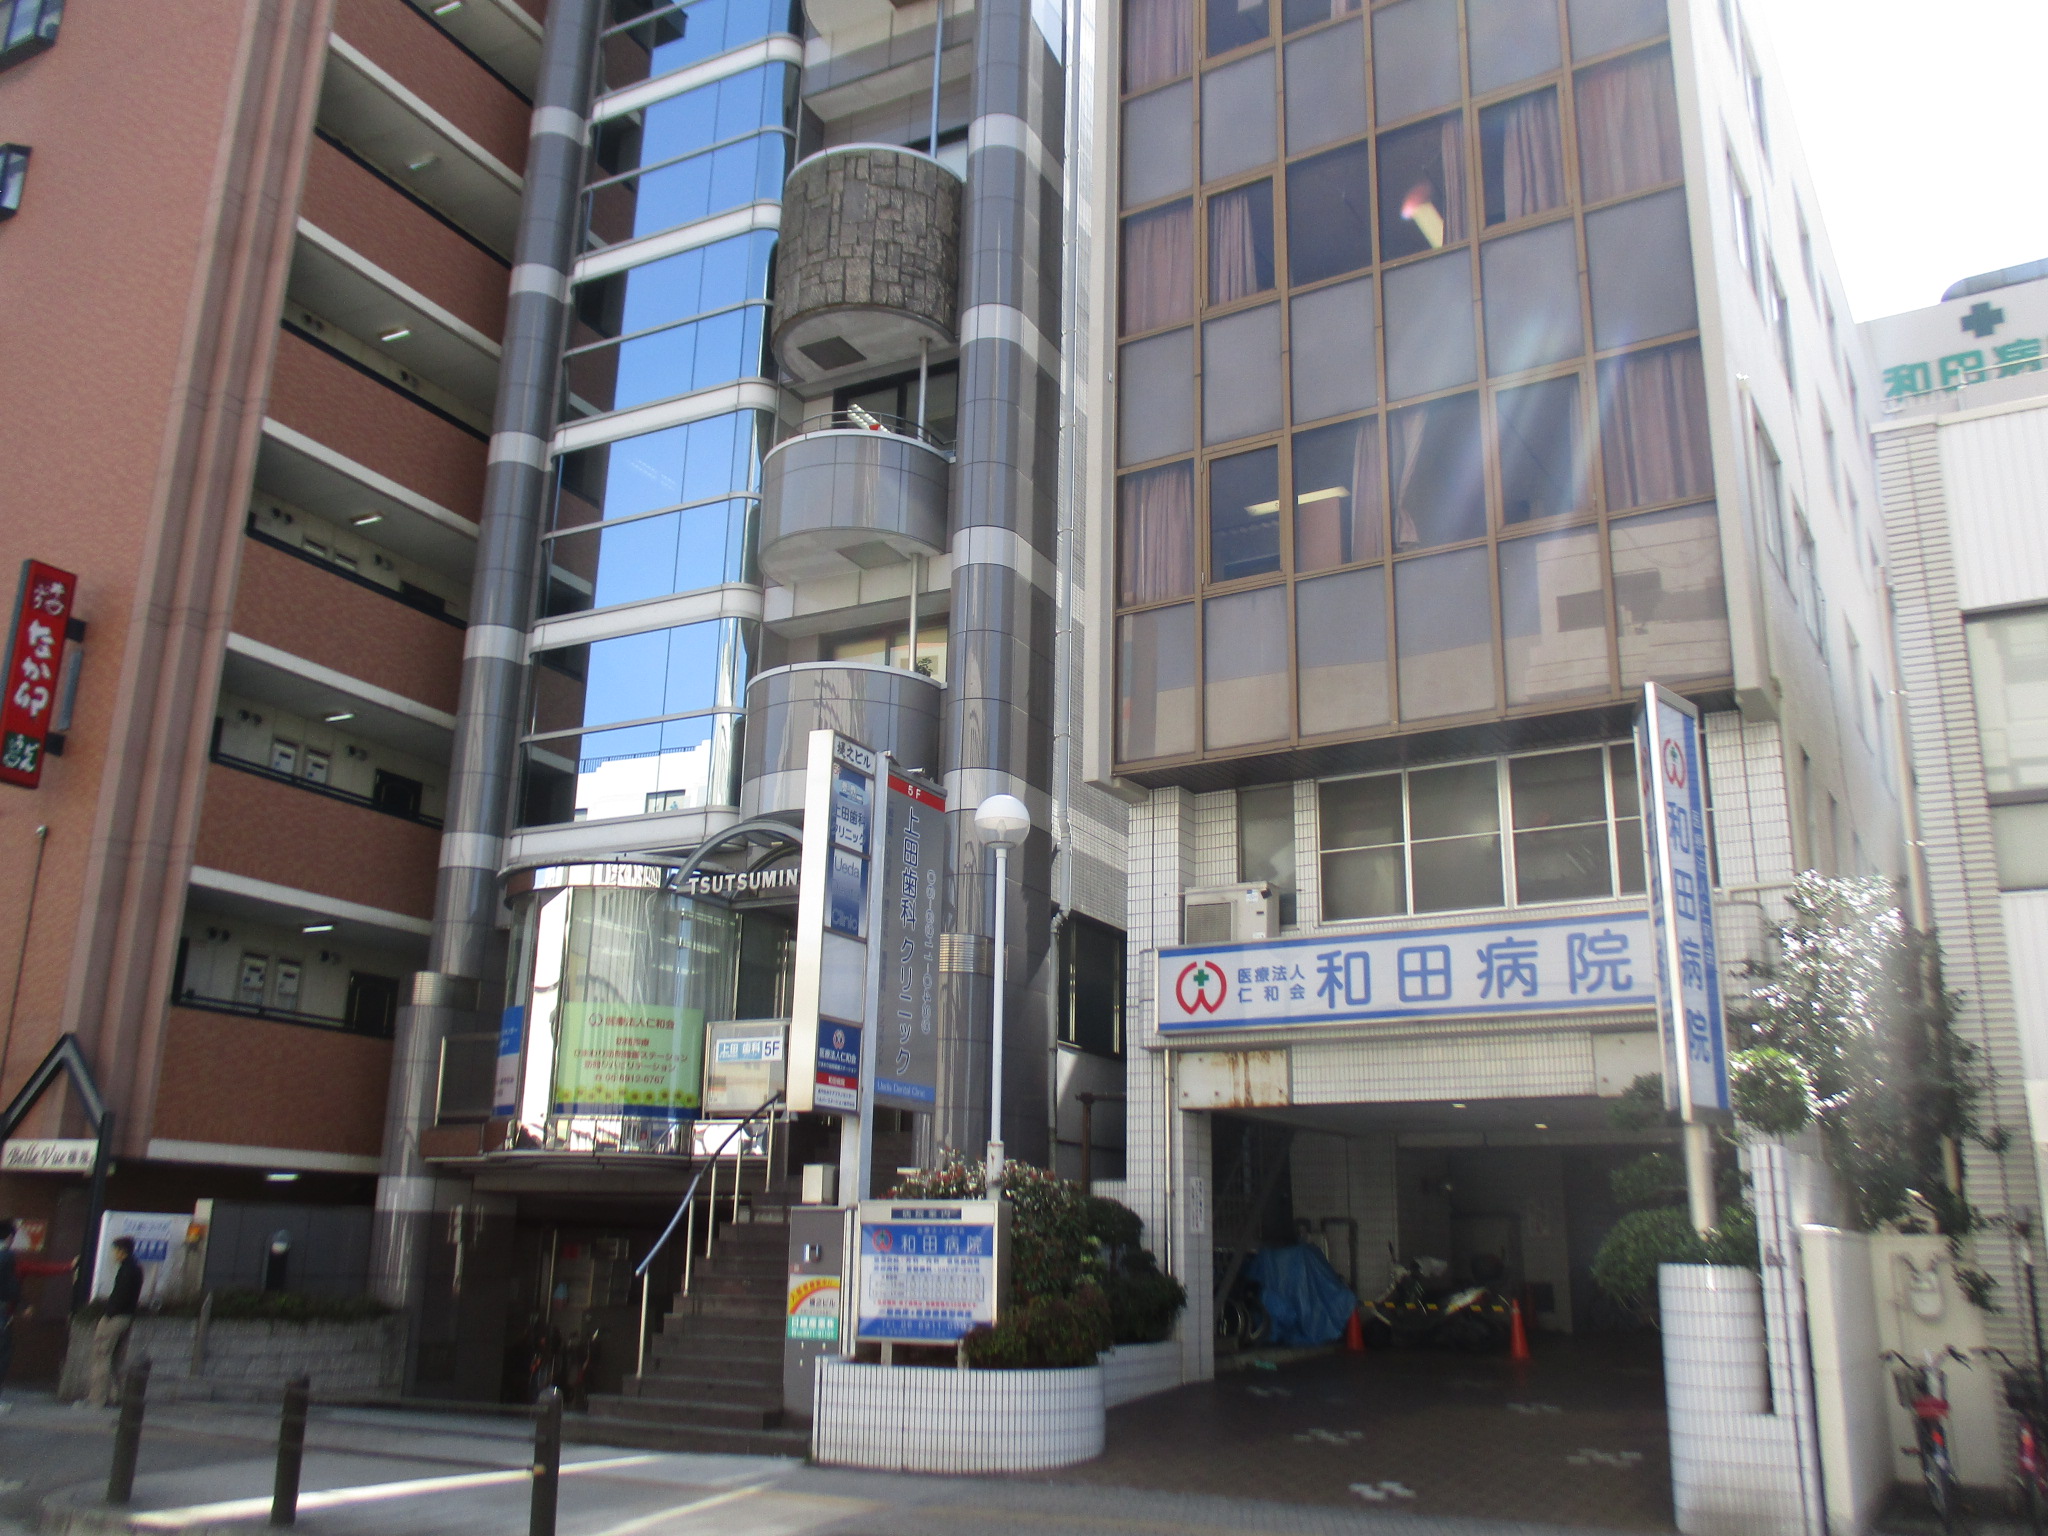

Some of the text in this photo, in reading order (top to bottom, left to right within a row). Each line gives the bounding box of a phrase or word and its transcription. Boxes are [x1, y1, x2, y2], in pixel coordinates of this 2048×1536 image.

[907, 785, 921, 799] 5F
[834, 804, 866, 830] 上田歯科
[831, 824, 865, 847] クリニック
[834, 856, 860, 879] Ueda
[832, 908, 858, 931] Clinic
[896, 806, 920, 1076] 上田歯科 クリニック
[1665, 801, 1711, 1063] 和田病院
[1237, 963, 1306, 984] 医療法人
[1316, 932, 1633, 1011] 和田病院
[1237, 984, 1306, 1003] 仁和会
[605, 1016, 675, 1030] 医療法人仁和会
[764, 1040, 781, 1056] 5F
[819, 1047, 857, 1065] 医療法人仁和会
[893, 1083, 911, 1096] Dental
[901, 1234, 982, 1255] 和田病院
